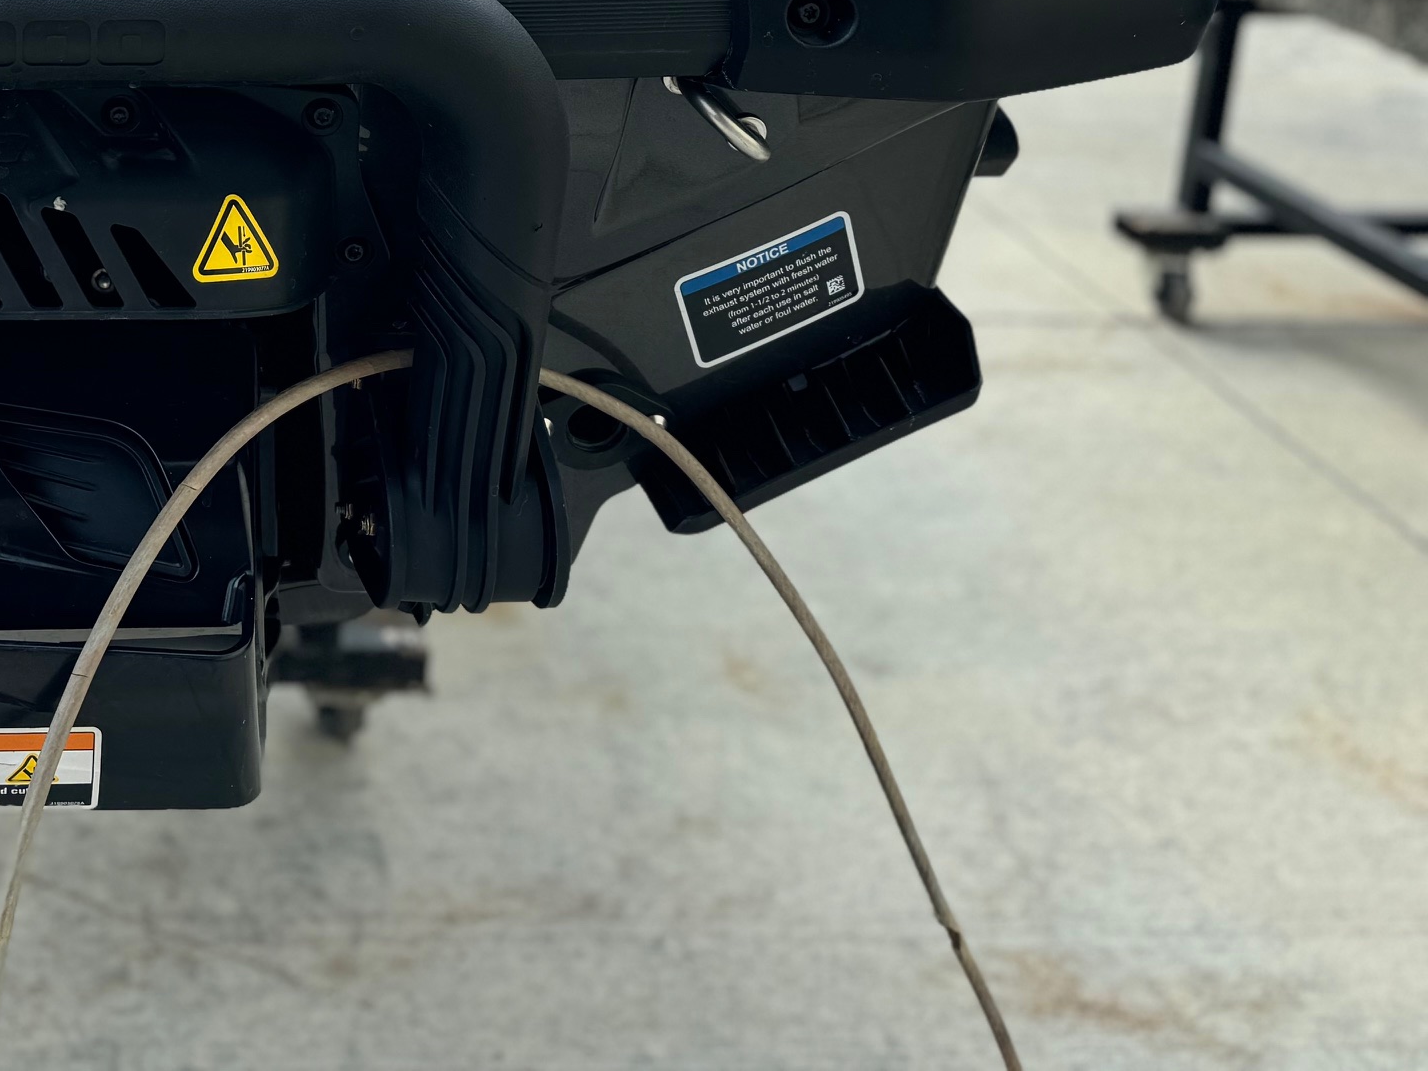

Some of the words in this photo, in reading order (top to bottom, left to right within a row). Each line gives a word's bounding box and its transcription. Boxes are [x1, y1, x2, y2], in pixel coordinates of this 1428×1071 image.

[704, 297, 712, 306] It
[712, 294, 721, 302] is
[722, 286, 741, 299] very
[743, 268, 784, 291] important
[785, 263, 795, 272] to
[795, 253, 816, 268] flush
[817, 245, 832, 259] the
[736, 243, 790, 273] NOTICE
[702, 299, 738, 317] exhaust
[739, 284, 771, 303] system
[772, 276, 790, 291] with
[791, 265, 813, 280] fresh
[814, 253, 839, 269] water
[728, 305, 749, 320] (from
[751, 295, 770, 310] 1-1/2
[771, 291, 780, 301] to
[786, 274, 820, 293] minutes)
[731, 316, 751, 328] after
[753, 305, 775, 319] each
[775, 298, 792, 310] use
[793, 293, 802, 302] in
[803, 284, 819, 297] salt
[738, 322, 763, 335] water
[764, 316, 774, 325] or
[775, 307, 792, 320] foul
[793, 296, 819, 313] water.
